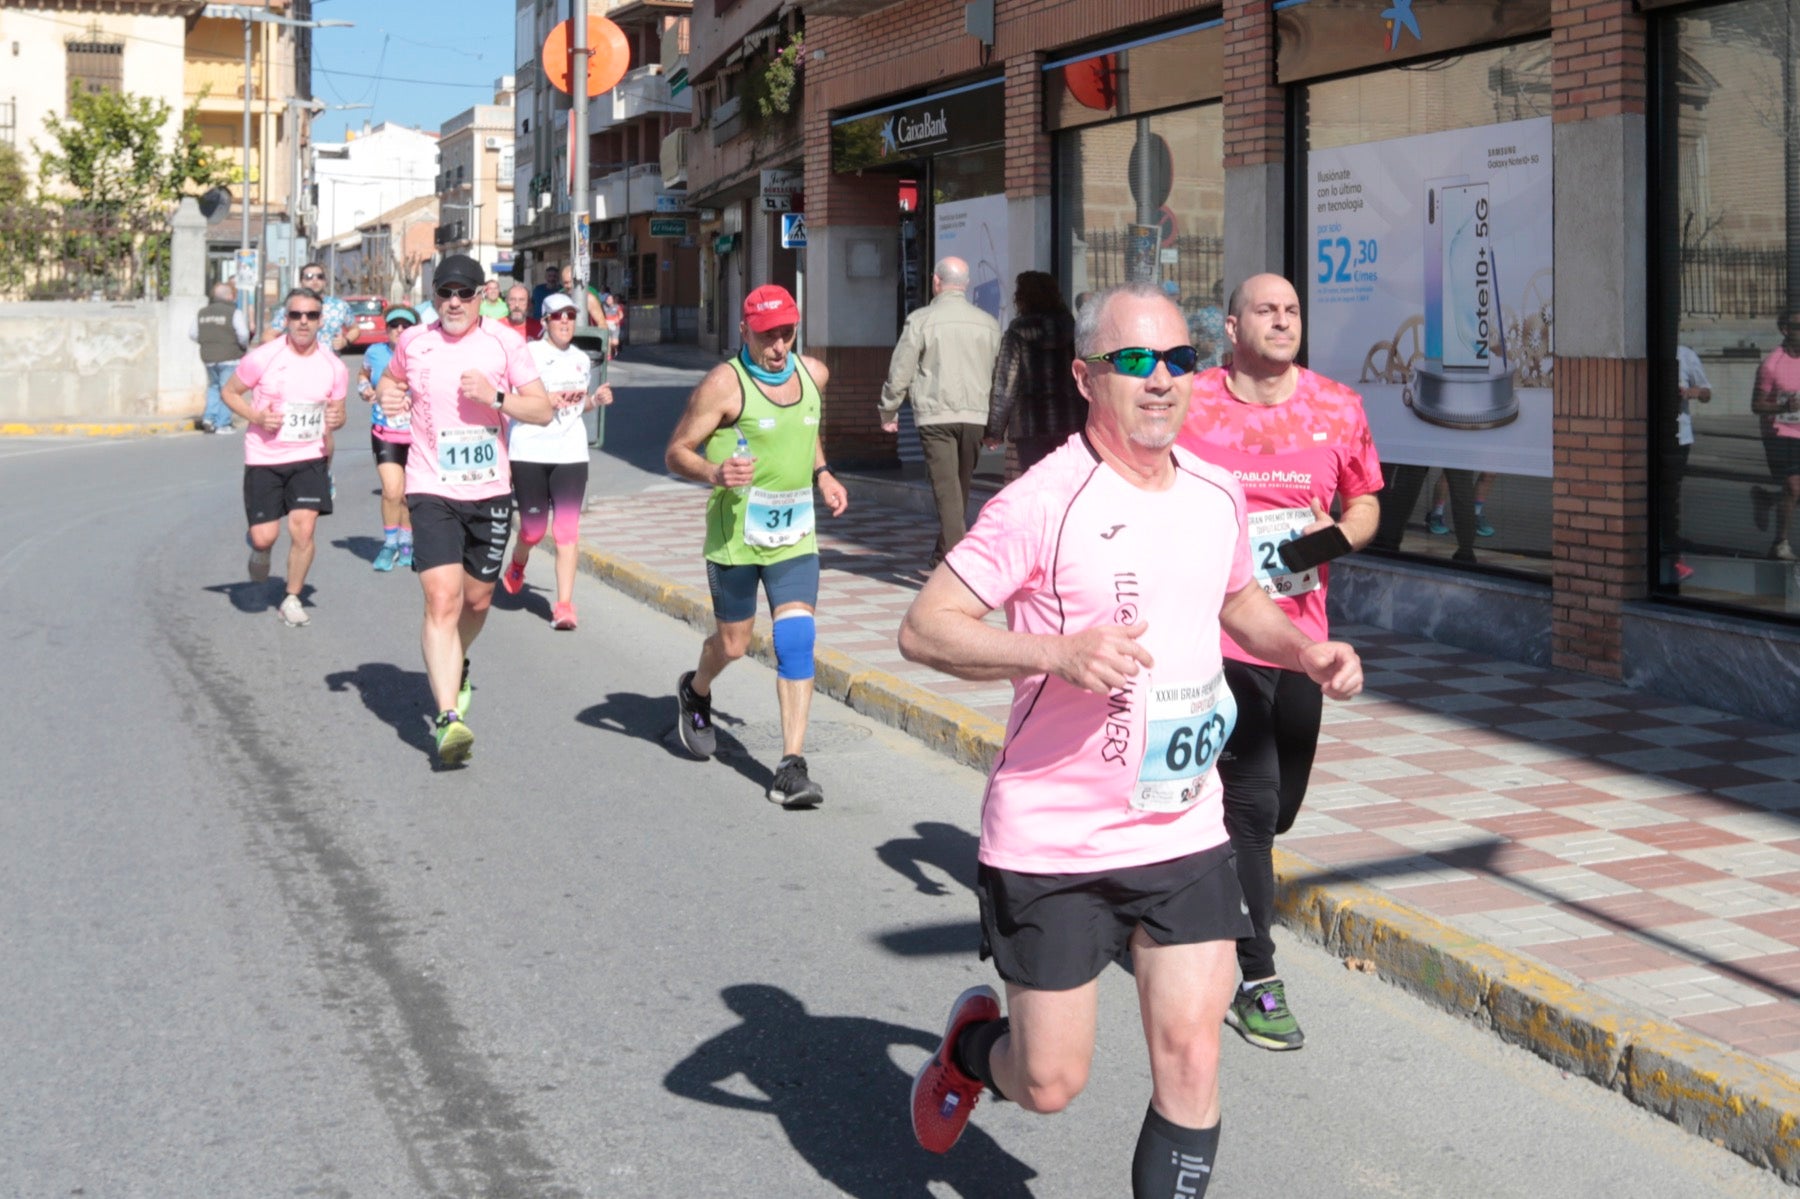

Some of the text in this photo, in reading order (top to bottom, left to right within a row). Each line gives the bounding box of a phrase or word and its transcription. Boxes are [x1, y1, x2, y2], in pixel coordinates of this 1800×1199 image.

[898, 108, 948, 143] CaixaBank
[1488, 146, 1516, 157] SAMSUNG
[1317, 188, 1330, 198] con
[1331, 184, 1338, 196] lo
[1317, 203, 1327, 213] en
[1476, 198, 1489, 360] Note10+ 5G
[289, 412, 322, 427] 3144
[446, 443, 494, 465] 1180
[1233, 470, 1312, 484] PABLO MUÑOZ
[766, 508, 793, 528] 31
[487, 507, 509, 560] NIKE
[1156, 689, 1179, 702] XXXIII
[1180, 687, 1200, 700] GRAN
